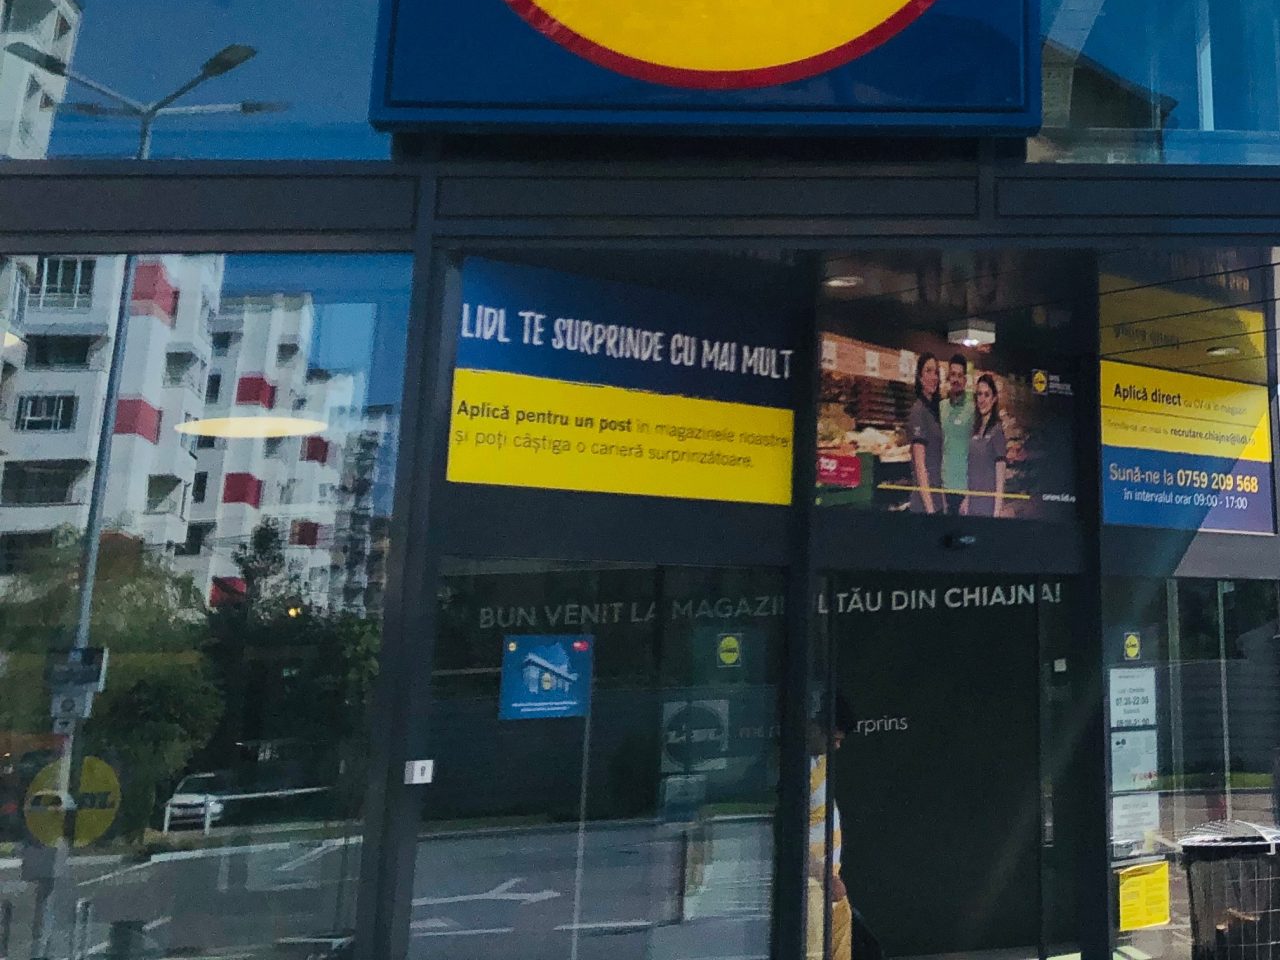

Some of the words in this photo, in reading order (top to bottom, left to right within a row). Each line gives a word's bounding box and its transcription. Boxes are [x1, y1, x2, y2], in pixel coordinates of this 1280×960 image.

[461, 303, 511, 343] LIDL
[518, 311, 547, 345] TE
[552, 317, 665, 362] SURPRINDE
[670, 334, 698, 367] CU
[701, 340, 738, 373] MAI
[741, 345, 794, 380] MULT
[1114, 383, 1148, 401] Aplică
[1151, 388, 1181, 406] direct
[457, 400, 510, 421] Aplică
[515, 408, 569, 428] pentru
[575, 416, 594, 429] un
[599, 418, 632, 435] post
[655, 421, 735, 443] magazinele
[576, 440, 585, 453] o
[1109, 462, 1160, 485] Sună-ne
[1163, 468, 1173, 485] la
[1177, 469, 1208, 489] 0759
[1211, 472, 1233, 491] 209
[1236, 474, 1259, 493] 568
[1135, 489, 1173, 504] intervalul
[1175, 494, 1191, 505] orar
[1194, 493, 1217, 507] 09:00
[1225, 496, 1248, 510] 17:00
[480, 606, 537, 629] BUN
[544, 601, 624, 626] VENIT
[837, 587, 882, 613] TĂU
[891, 589, 936, 611] DIN
